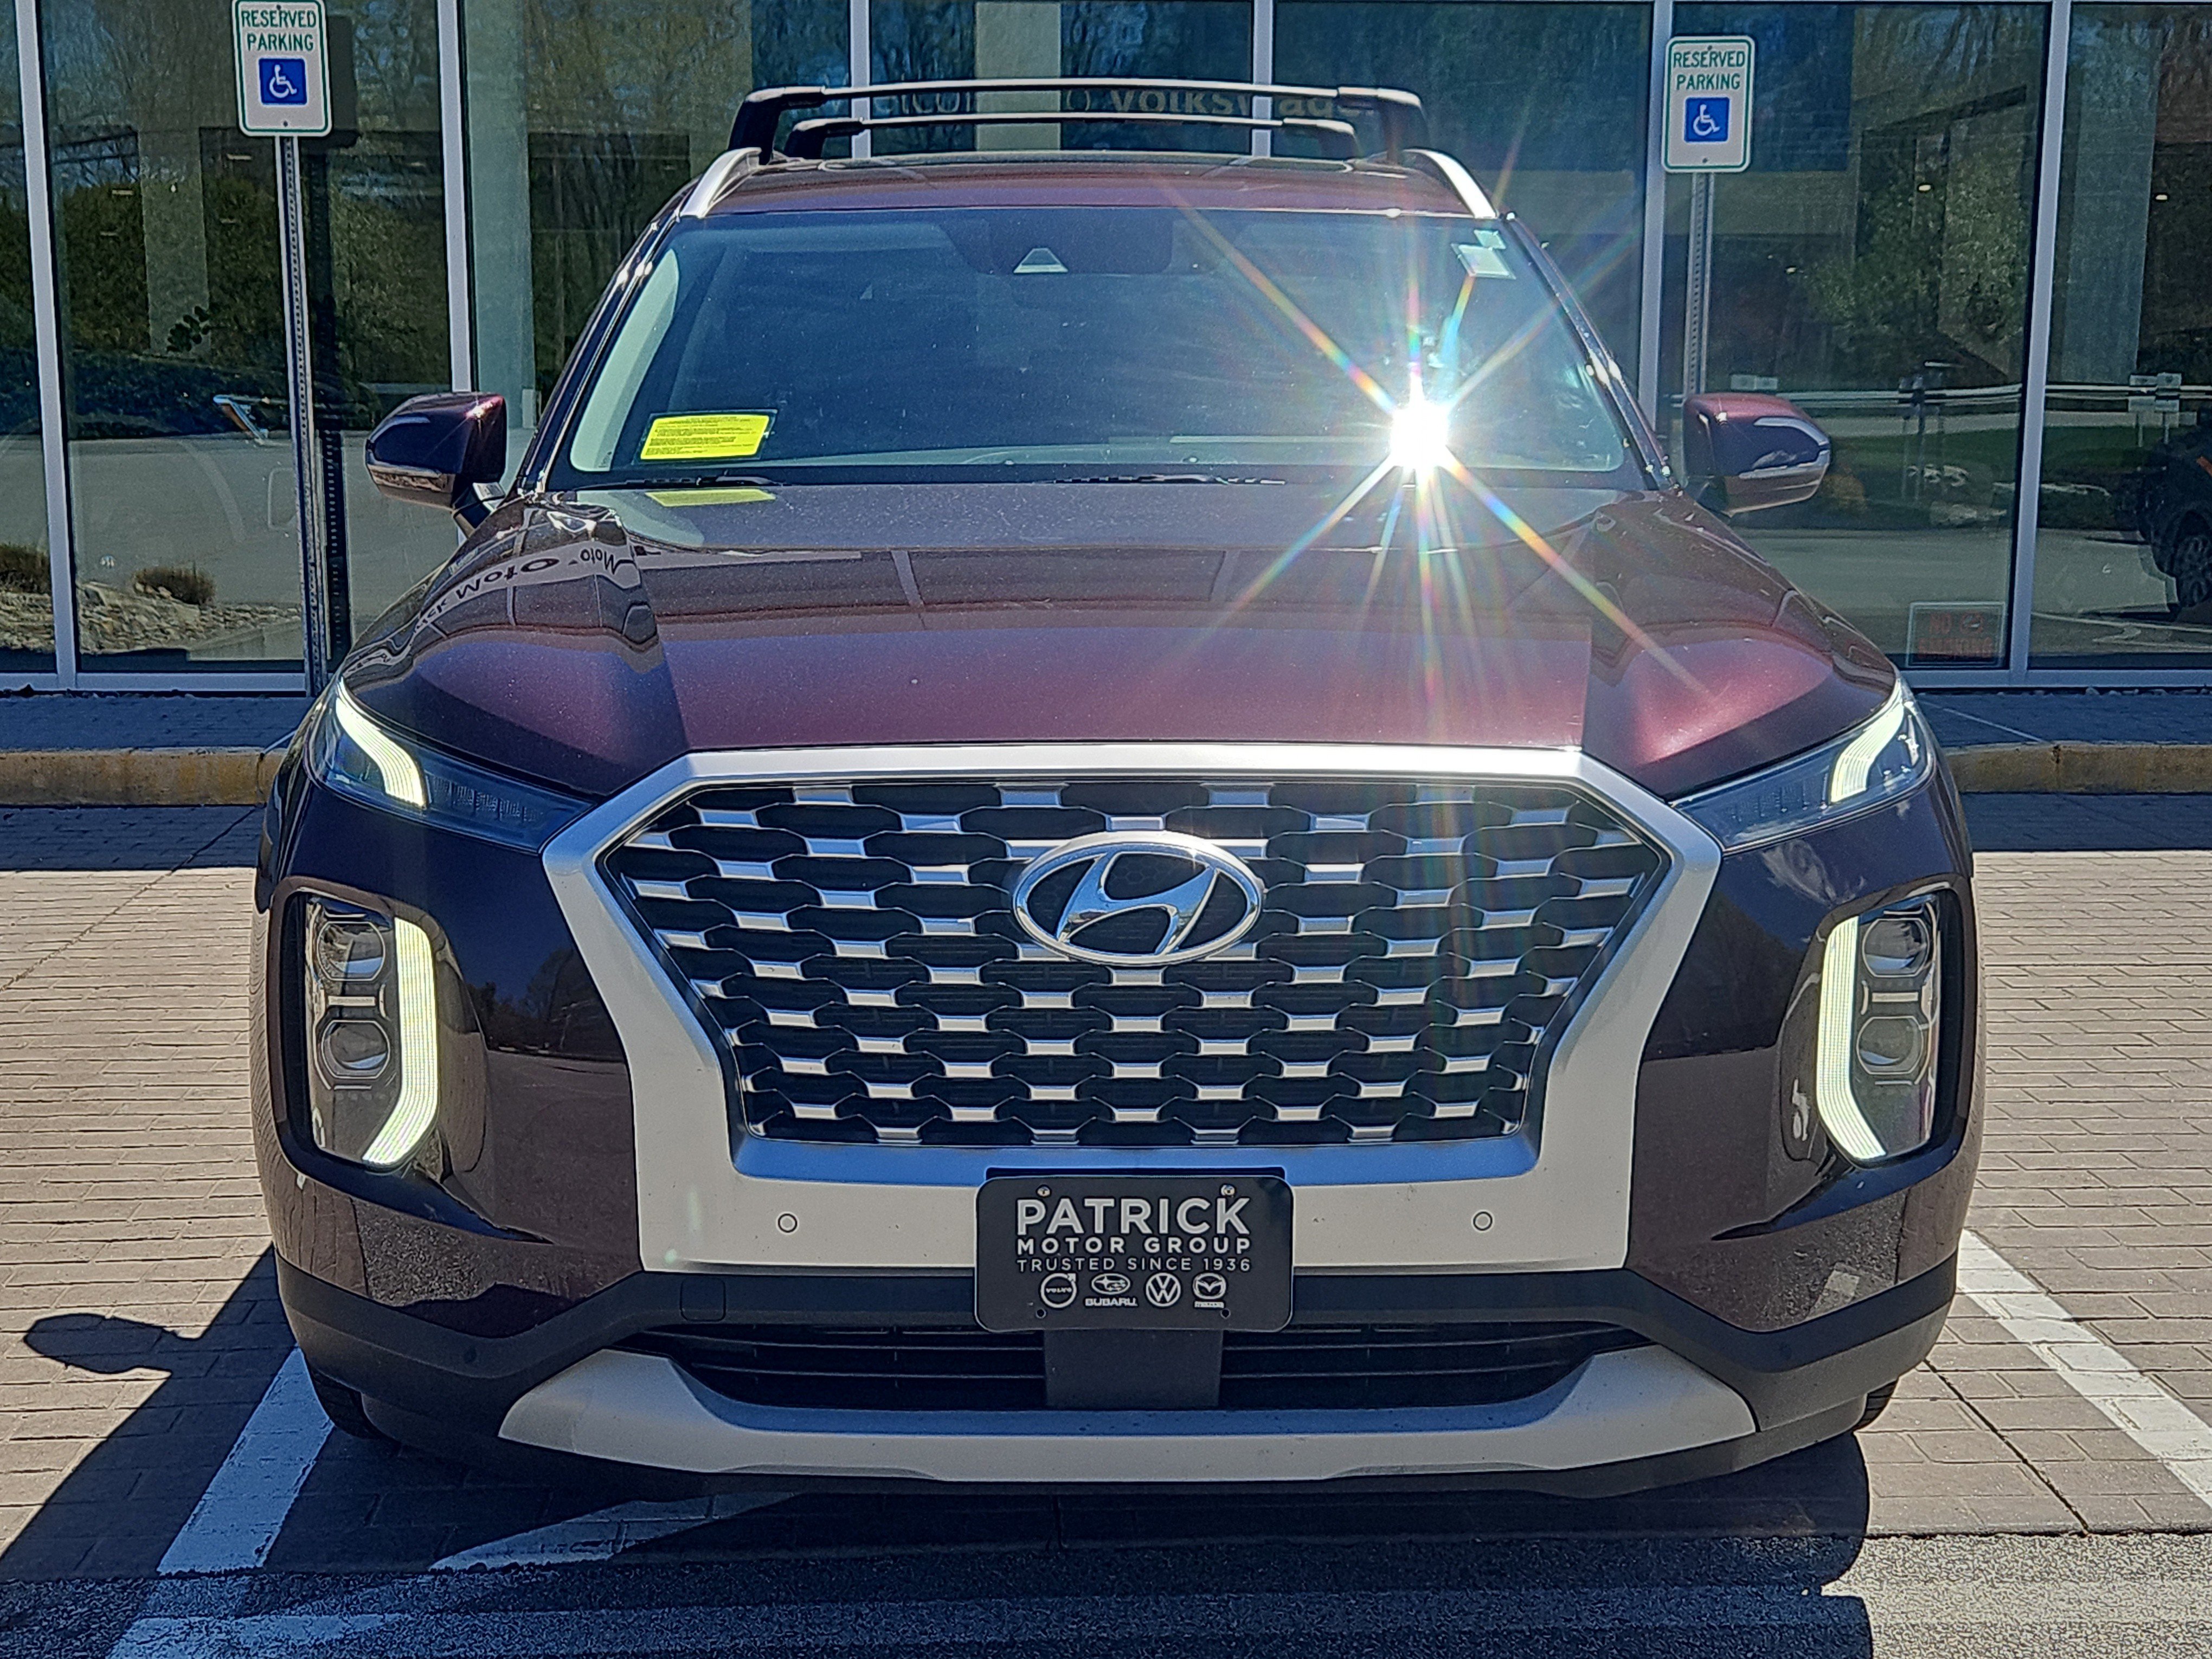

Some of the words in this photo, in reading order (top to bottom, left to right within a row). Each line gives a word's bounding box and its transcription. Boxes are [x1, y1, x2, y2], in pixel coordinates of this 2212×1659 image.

[241, 10, 317, 28] RESERVED
[247, 33, 314, 52] PARKING
[1673, 50, 1745, 68] RESERVED
[1676, 73, 1740, 91] PARKING
[1017, 1198, 1250, 1235] PATRICK
[1018, 1237, 1125, 1255] MOTOR
[1144, 1237, 1250, 1255] GROUP
[1017, 1258, 1115, 1272] TRUSTED
[1128, 1257, 1191, 1271] SINCE
[1203, 1258, 1250, 1271] 1936
